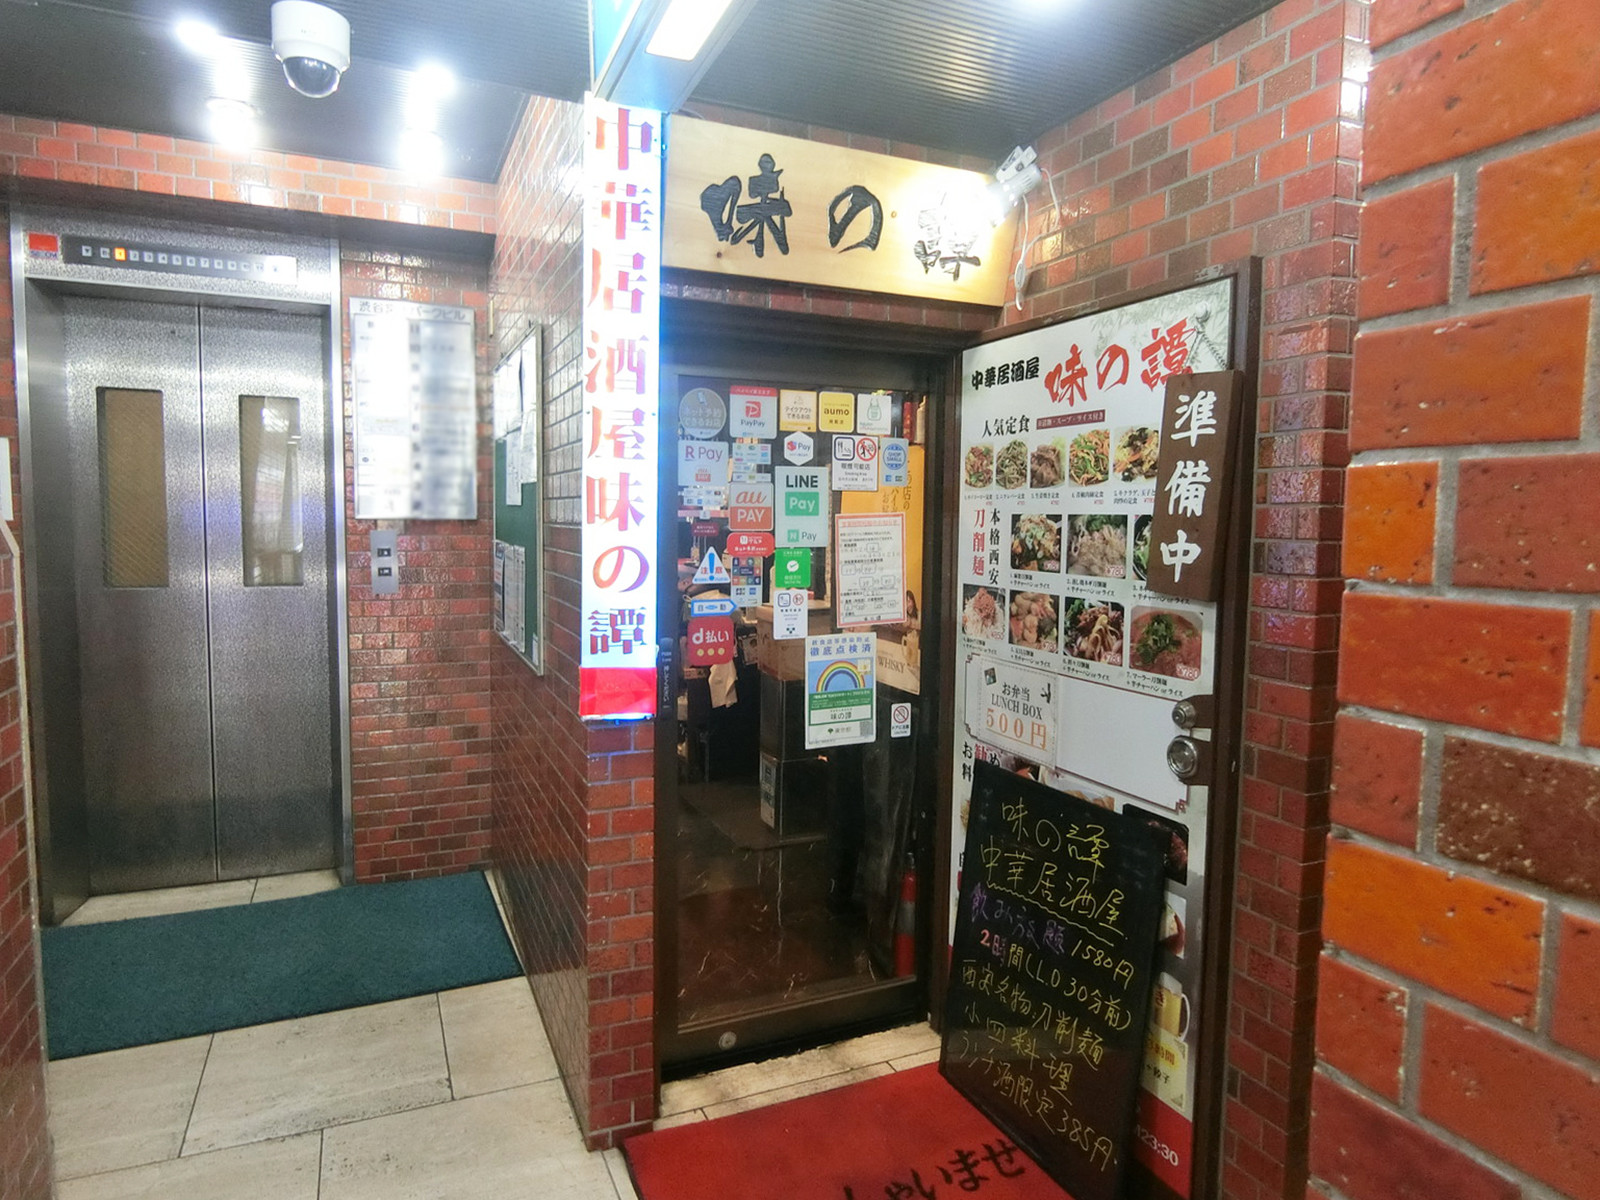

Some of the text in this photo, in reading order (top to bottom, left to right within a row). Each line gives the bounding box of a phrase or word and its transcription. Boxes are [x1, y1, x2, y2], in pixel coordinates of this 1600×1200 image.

[972, 357, 1040, 391] 中華居酒屋
[824, 408, 850, 416] aumo
[741, 419, 766, 427] PayPay
[982, 414, 1031, 438] 人気定食
[685, 446, 724, 462] R Pay
[797, 442, 811, 453] Pay
[786, 475, 818, 488] LINE
[1160, 390, 1218, 583] 準備中
[736, 491, 767, 504] au
[789, 496, 816, 512] Pay
[738, 509, 765, 522] PAY
[801, 531, 817, 544] Pay
[989, 507, 1000, 585] 本格西安
[692, 628, 729, 645] d払い
[811, 644, 872, 657] 徹底点検済
[1002, 682, 1030, 702] お弁当
[991, 693, 1042, 720] LUNCH BOX
[986, 708, 1047, 750] 500円
[1071, 939, 1135, 990] 1580円
